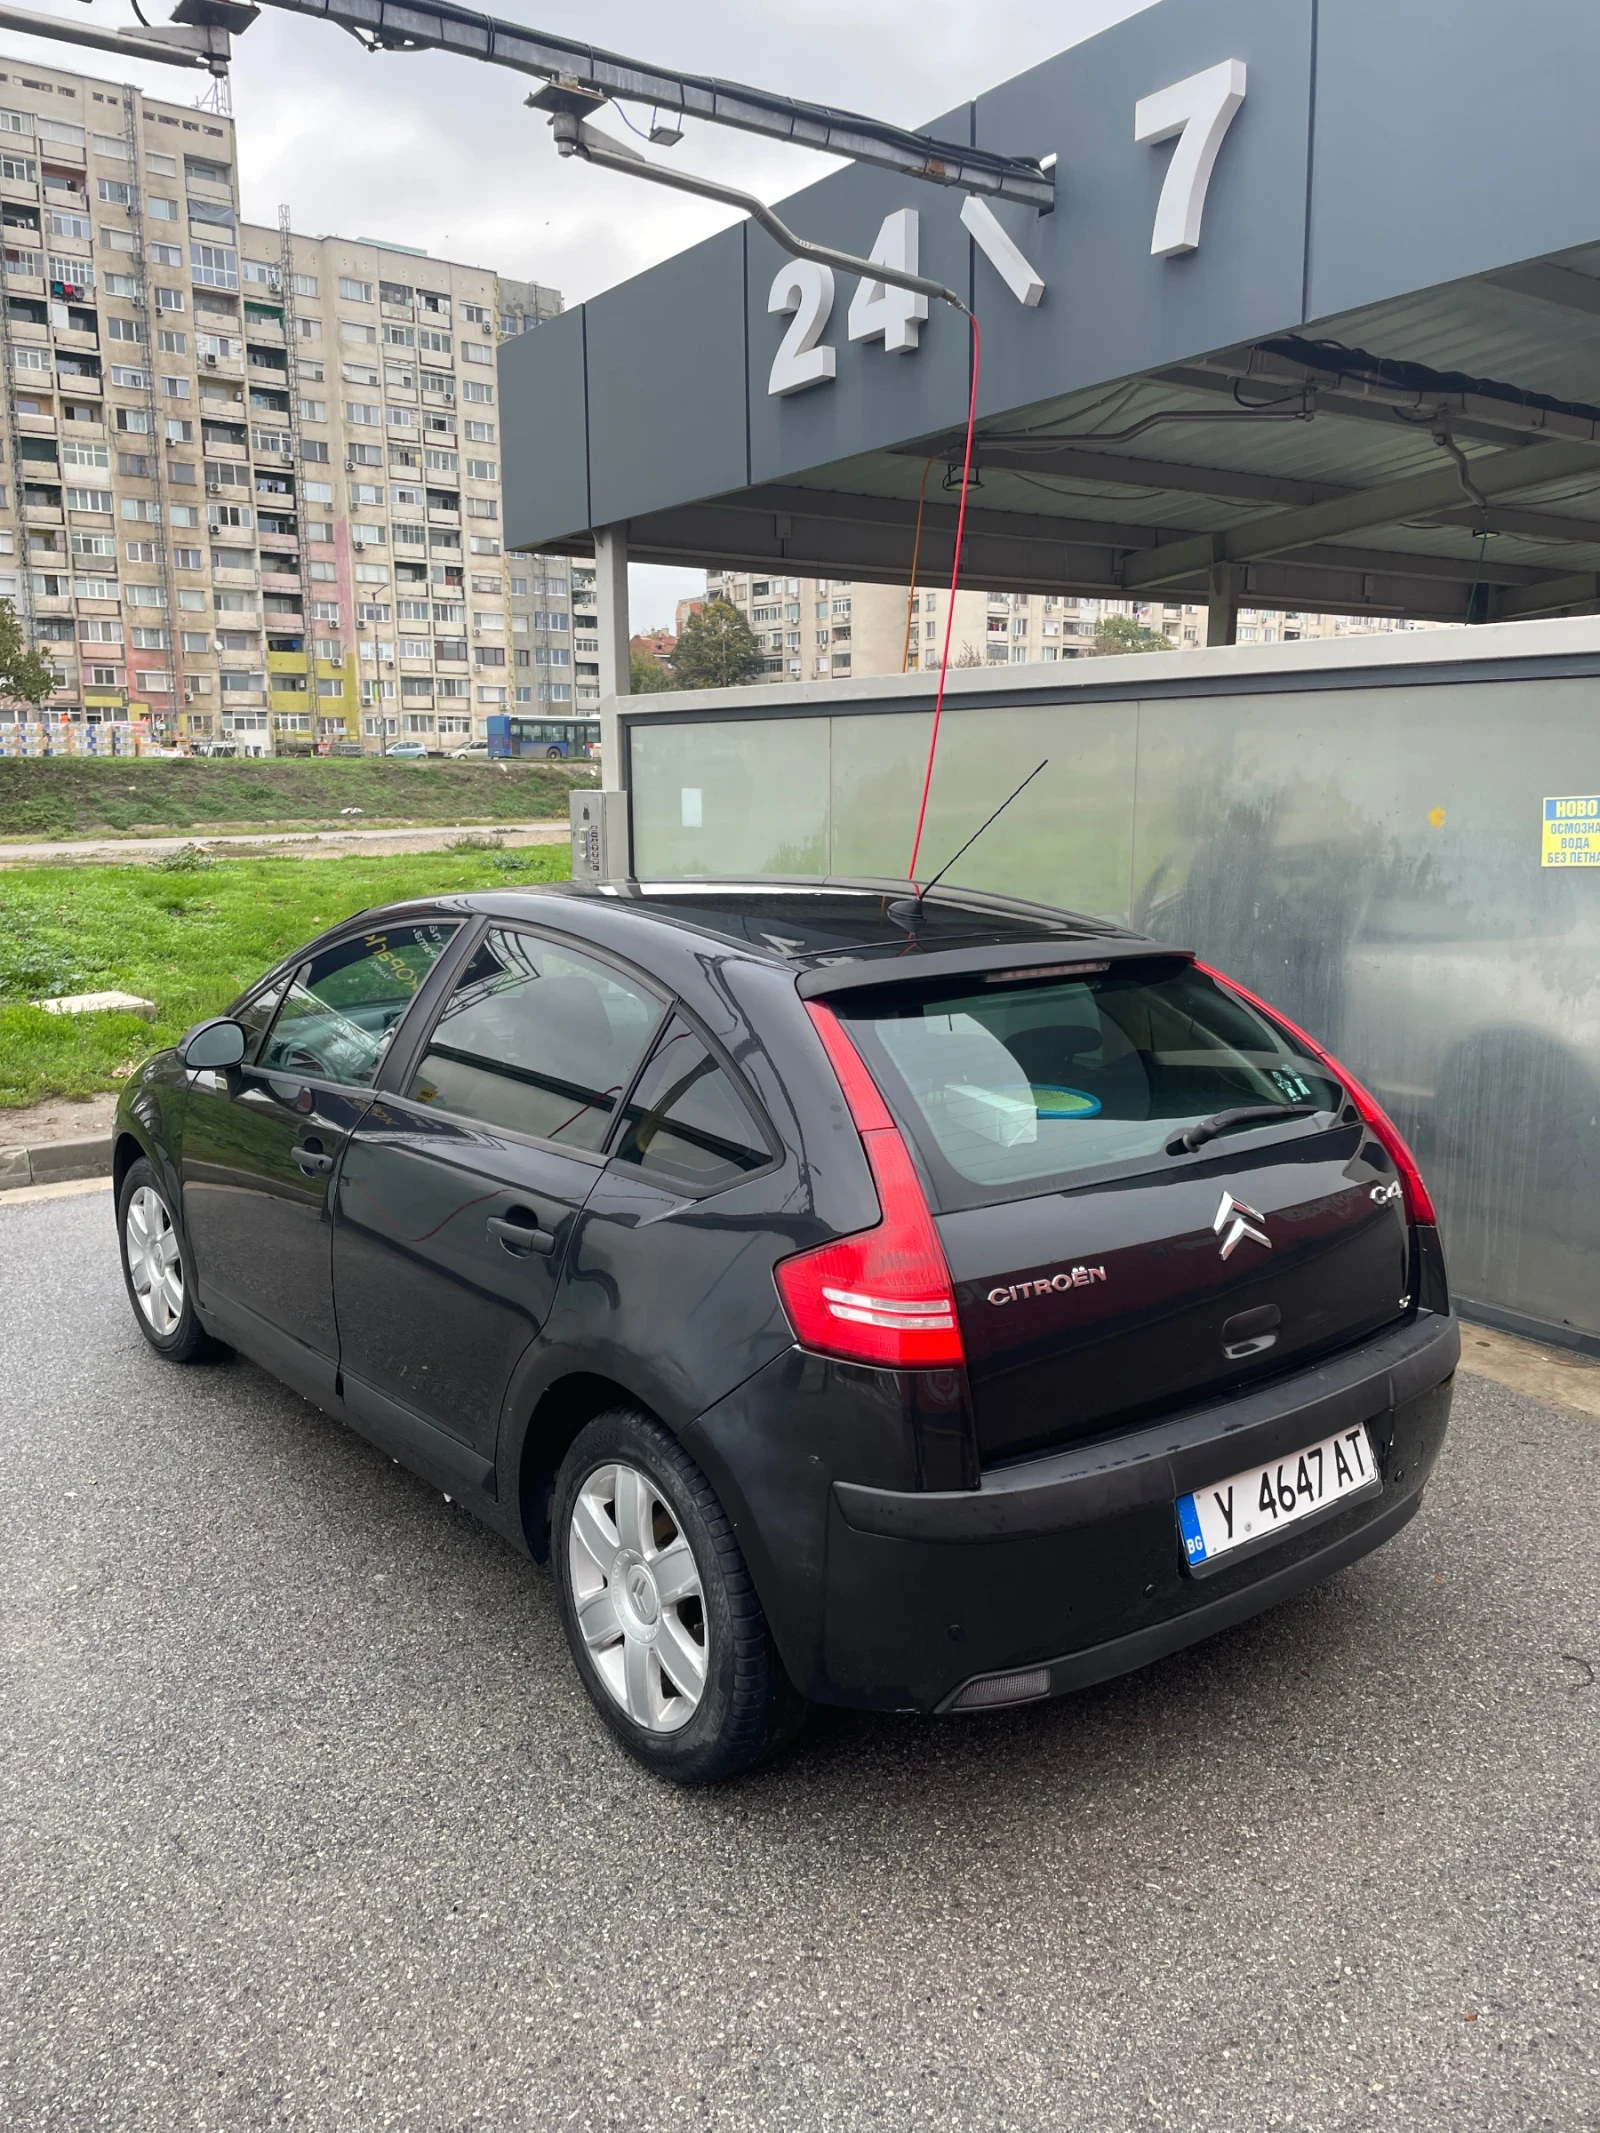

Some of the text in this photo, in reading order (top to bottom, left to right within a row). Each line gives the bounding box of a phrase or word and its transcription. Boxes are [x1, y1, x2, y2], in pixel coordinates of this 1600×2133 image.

[1555, 800, 1598, 818] НОВО
[1561, 837, 1590, 850] ВОДА
[1547, 852, 1567, 864] БЕЗ
[1369, 1180, 1403, 1204] C4
[987, 1266, 1107, 1306] CITROËN
[1258, 1447, 1323, 1519] 4647
[1332, 1429, 1365, 1488] AT
[1186, 1535, 1204, 1554] BG
